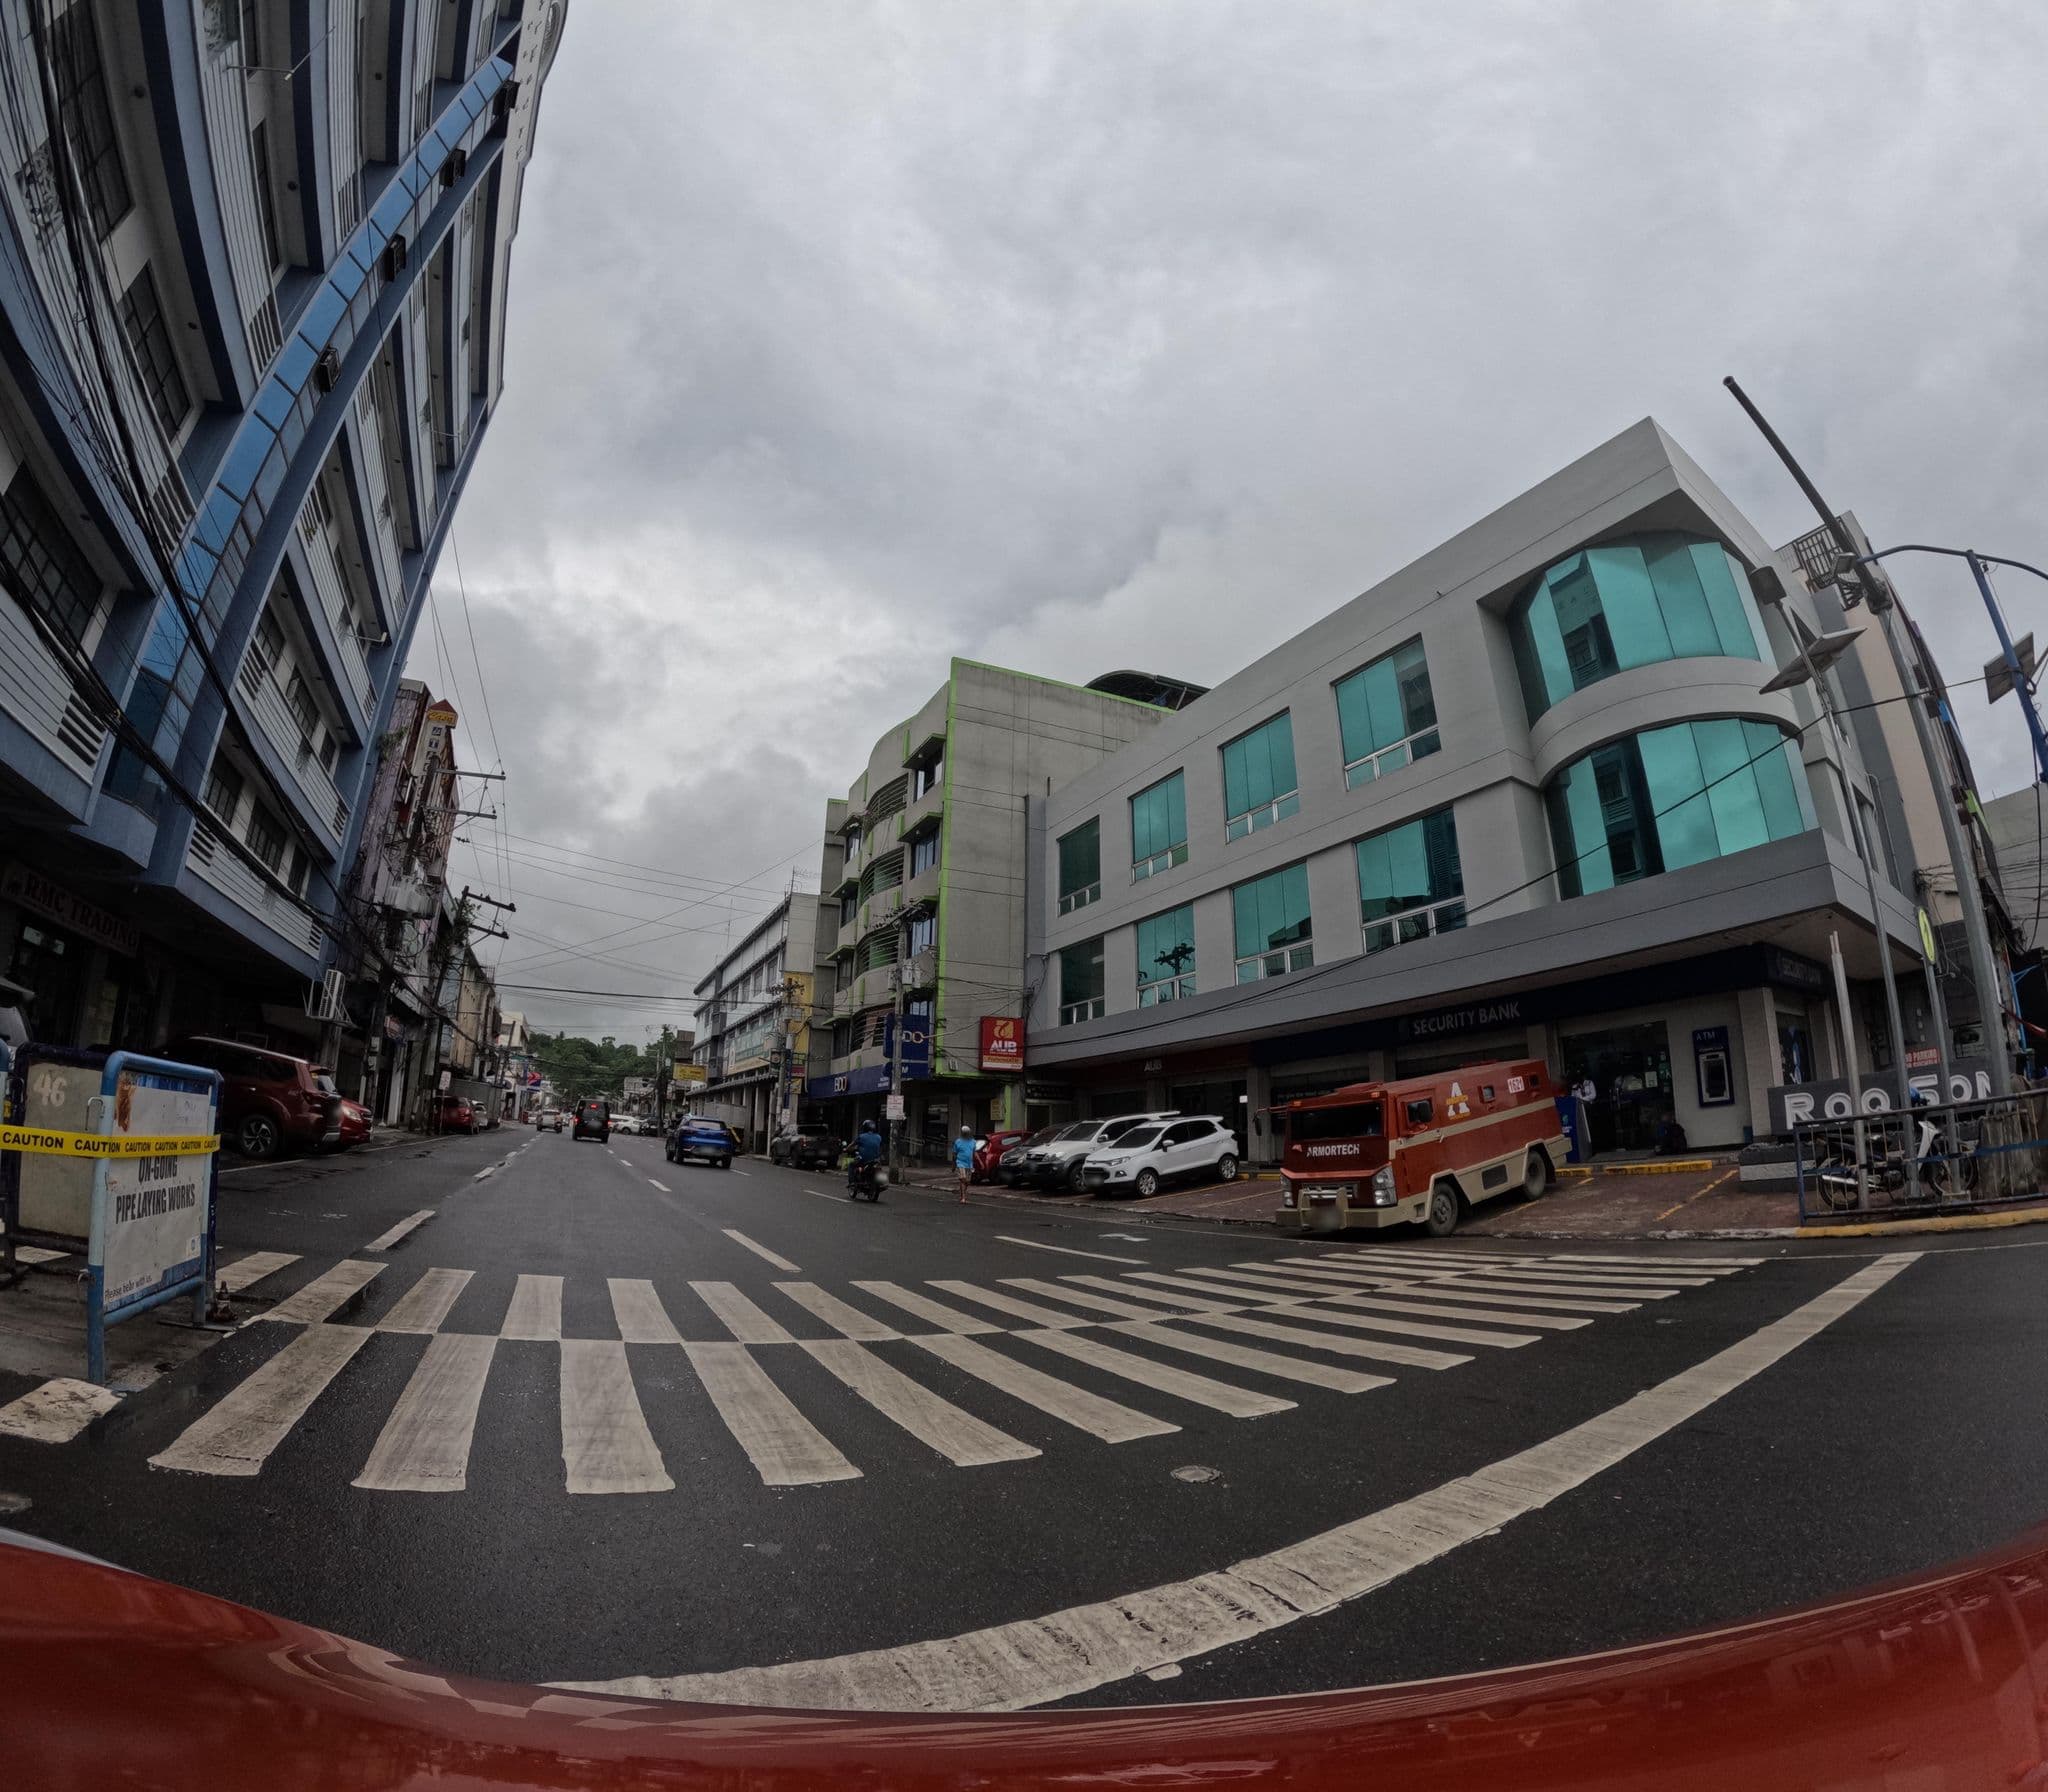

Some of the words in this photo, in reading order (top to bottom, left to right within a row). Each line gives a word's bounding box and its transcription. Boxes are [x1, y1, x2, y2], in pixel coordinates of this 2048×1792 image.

[23, 872, 68, 912] RMC
[70, 896, 141, 946] TRADING
[1413, 1009, 1476, 1035] SECURITY
[1479, 1000, 1521, 1024] BANK
[990, 1040, 1018, 1053] AUB
[1696, 1031, 1715, 1041] ATM
[33, 1072, 67, 1107] 46
[2, 1131, 64, 1149] CAUTION
[74, 1139, 121, 1153] CAUTION
[125, 1142, 151, 1153] CAUTION
[154, 1141, 178, 1152] CAUTION
[181, 1140, 202, 1150] CAUTION
[1306, 1143, 1360, 1157] ARMORTECH
[138, 1155, 178, 1183] ON-GOING
[115, 1193, 136, 1225] PIPE
[137, 1188, 167, 1219] LAYING
[168, 1183, 195, 1212] WORKS
